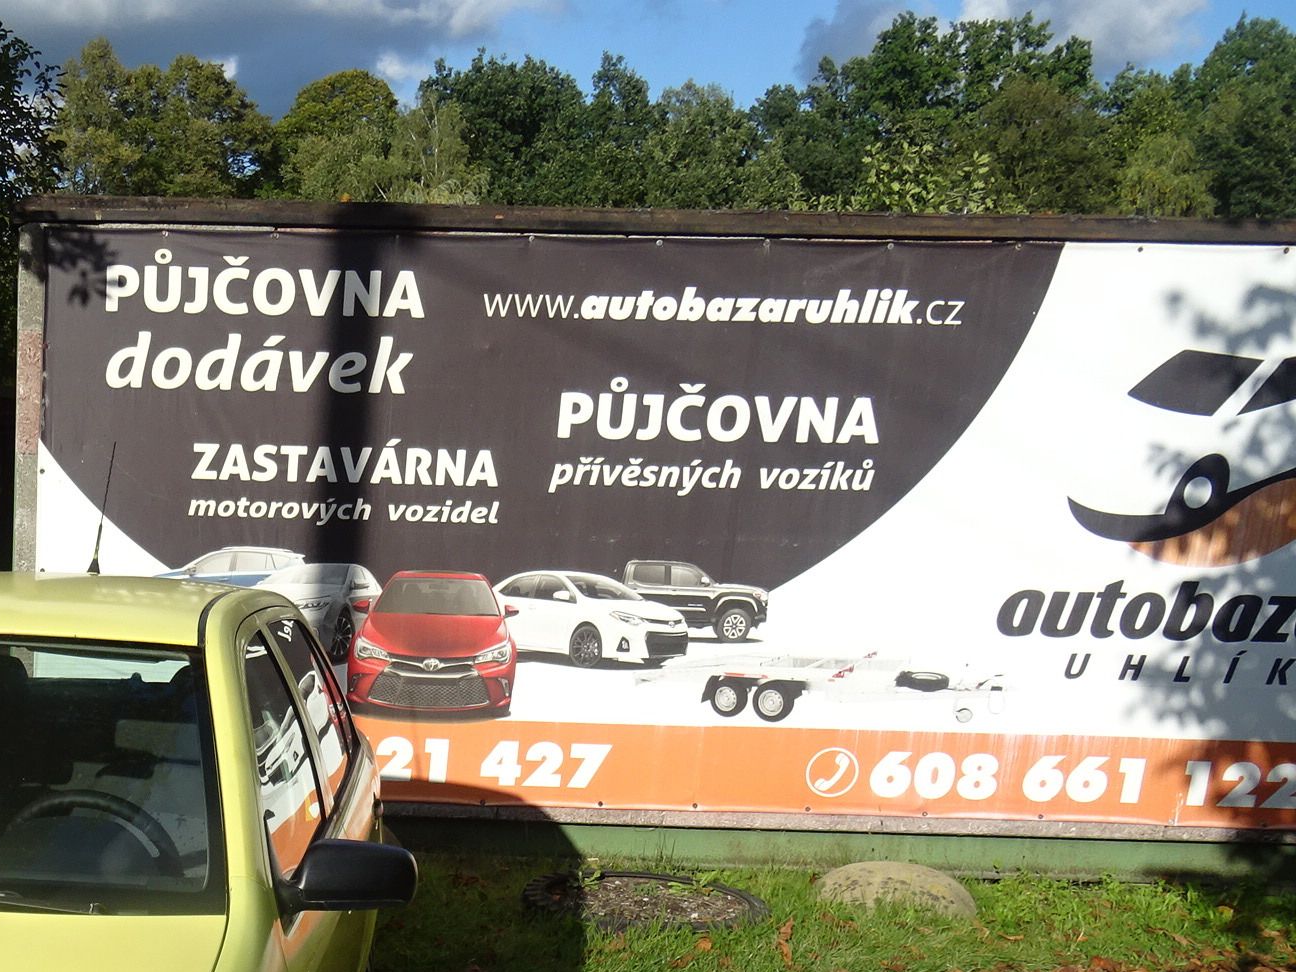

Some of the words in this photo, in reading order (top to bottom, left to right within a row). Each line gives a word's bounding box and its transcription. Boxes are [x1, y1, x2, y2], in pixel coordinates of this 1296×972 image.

[105, 248, 424, 319] PŮJČOVNA
[483, 286, 964, 326] www.autobazaruhlik.cz
[105, 331, 413, 395] dodávek
[557, 376, 879, 445] PŮJČOVNA
[191, 438, 498, 487] ZASTAVÁRNA
[548, 457, 742, 496] přívěsných
[758, 456, 875, 491] vozíků
[188, 497, 370, 526] motorových
[387, 501, 499, 525] vozidel
[996, 579, 1296, 643] autobaz
[480, 740, 613, 788] 427
[869, 751, 1000, 800] 608
[1022, 755, 1147, 804] 661
[1185, 760, 1296, 809] 122
